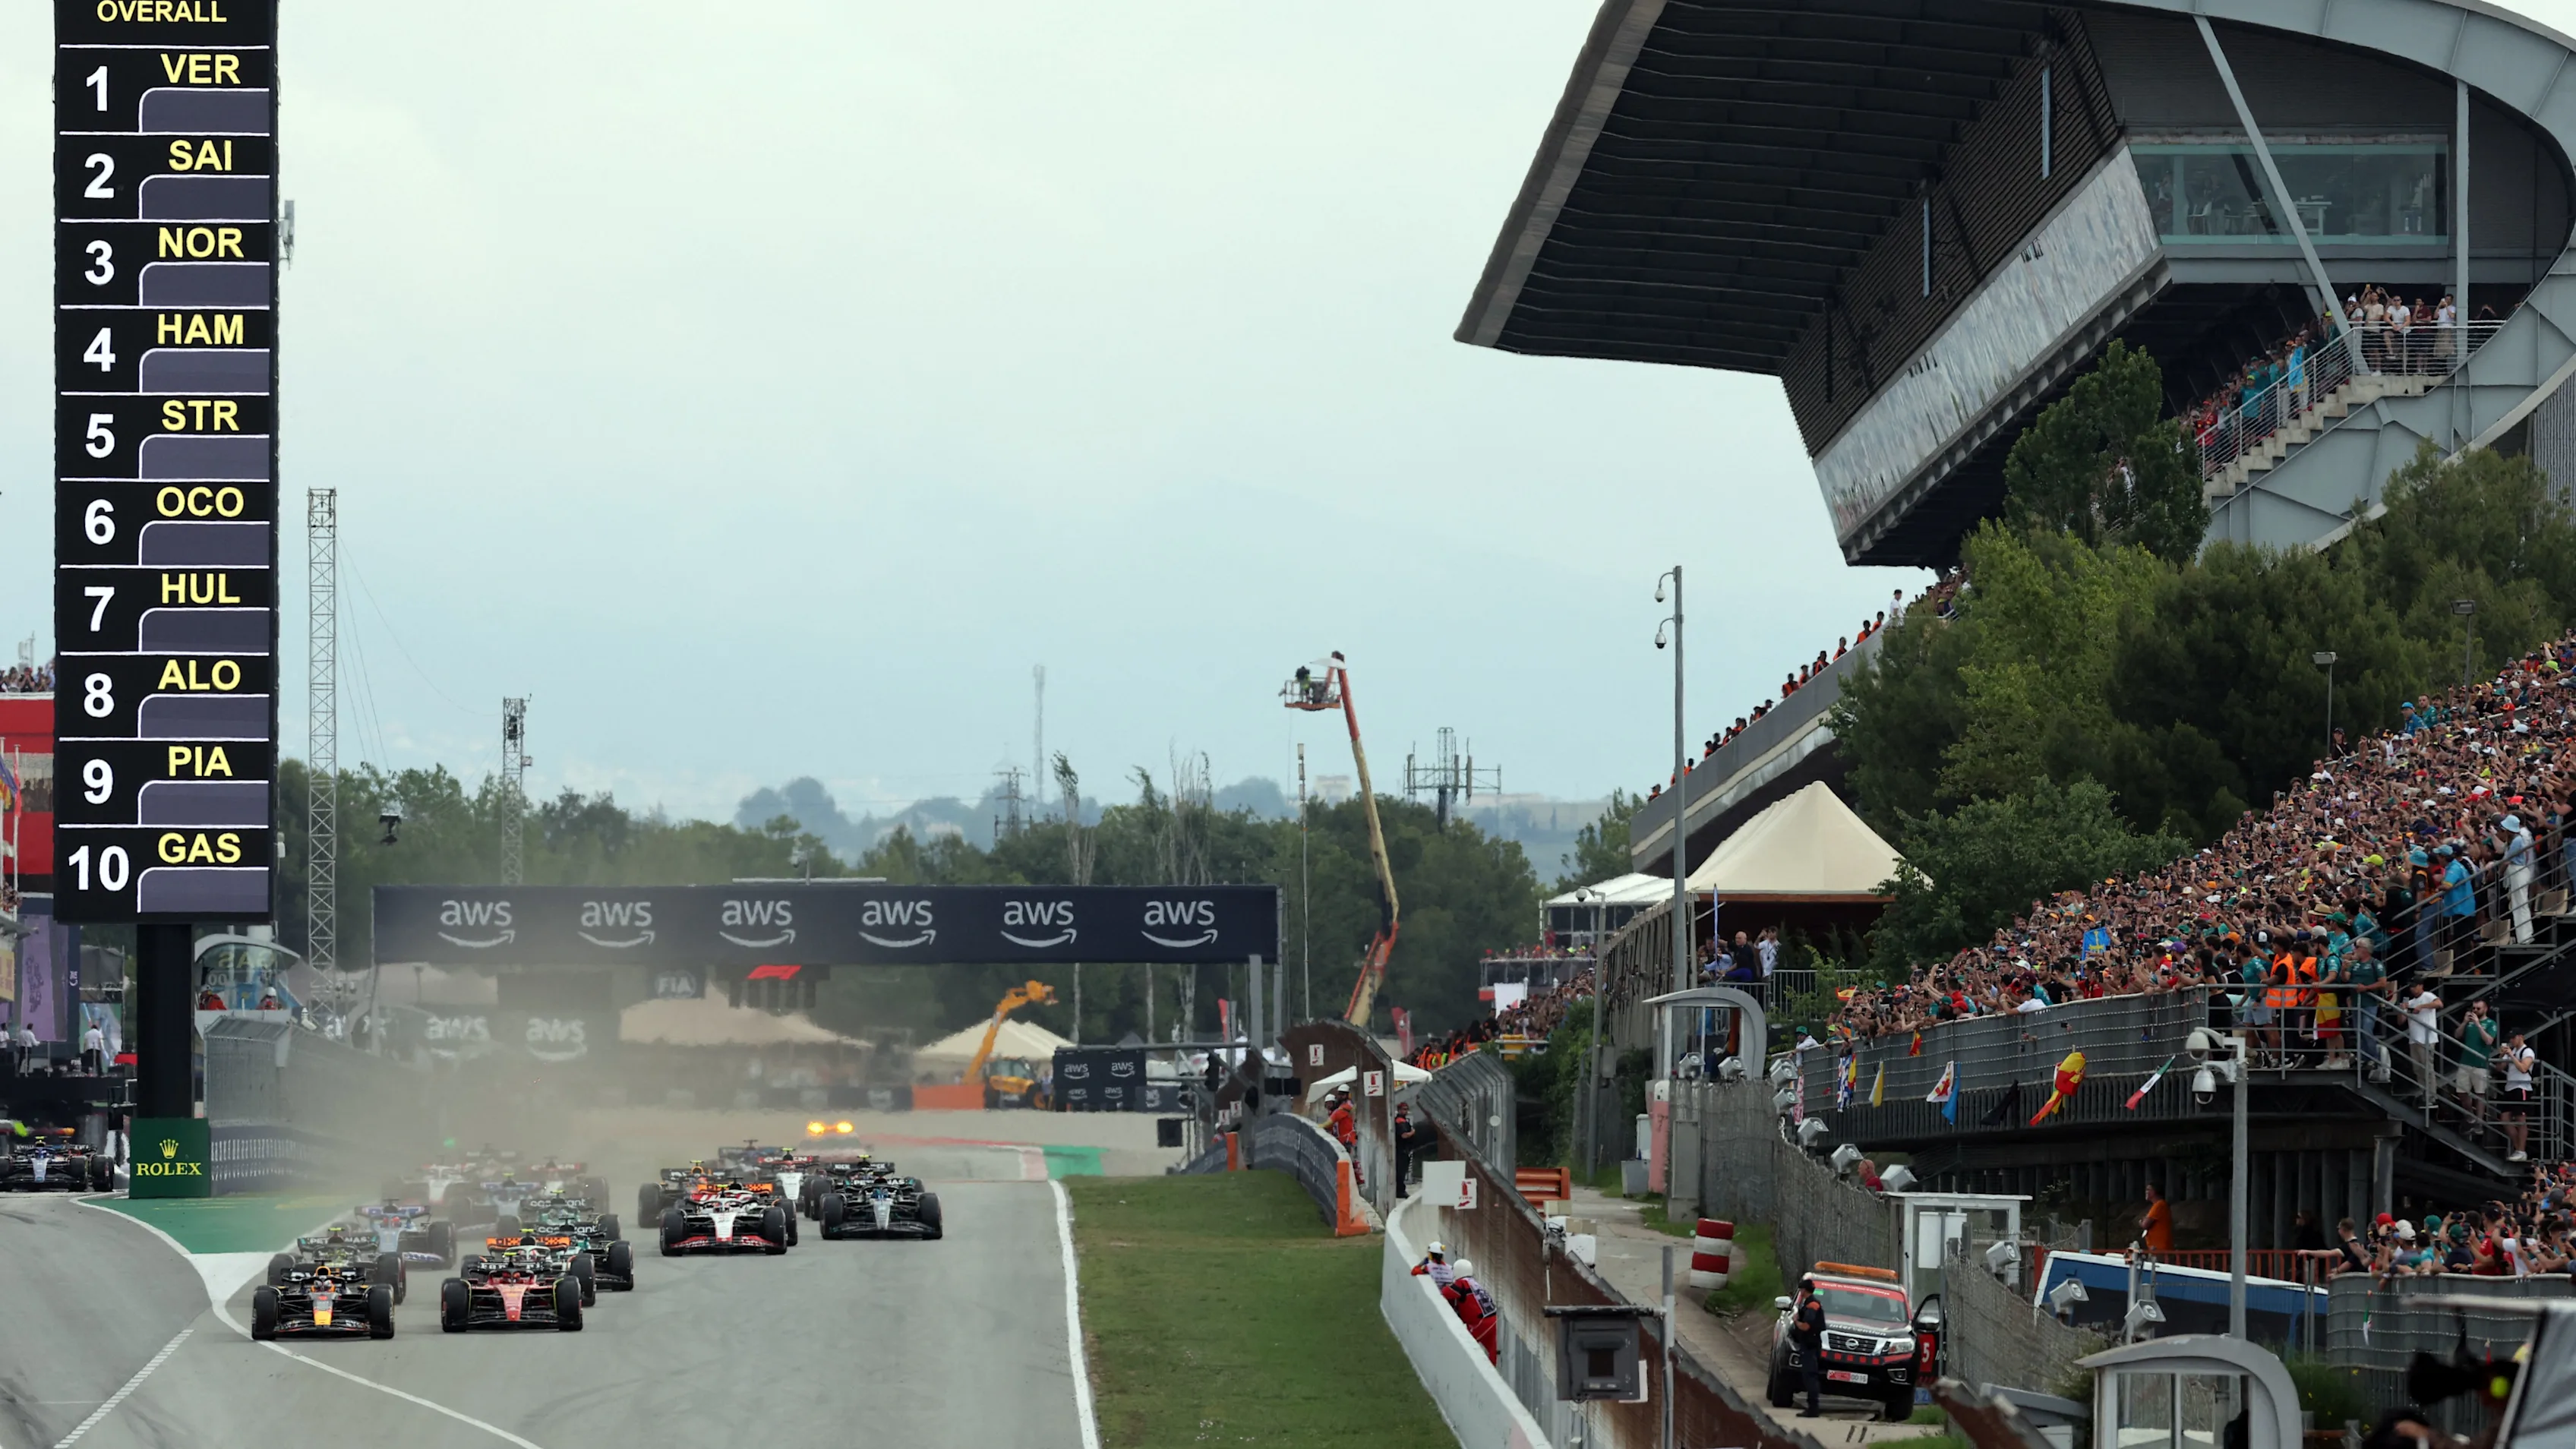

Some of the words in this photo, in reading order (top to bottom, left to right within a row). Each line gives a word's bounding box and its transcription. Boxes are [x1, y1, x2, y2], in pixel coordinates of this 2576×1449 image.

[96, 0, 227, 22] OVERALL
[161, 54, 240, 84] VER
[87, 66, 107, 111] 1
[169, 140, 231, 170] SAI
[84, 153, 114, 198] 2
[159, 228, 244, 257] NOR
[85, 240, 114, 285] 3
[158, 314, 243, 344] HAM
[84, 328, 115, 371] 4
[163, 400, 239, 431] STR
[86, 414, 115, 458] 5
[157, 487, 243, 517] OCO
[85, 500, 115, 545] 6
[163, 573, 240, 603] HUL
[85, 587, 114, 631] 7
[158, 660, 240, 690] ALO
[84, 673, 114, 717] 8
[169, 747, 232, 776] PIA
[84, 759, 112, 803] 9
[159, 833, 240, 863] GAS
[69, 846, 128, 891] 10
[440, 901, 512, 927] aws
[581, 902, 652, 927] aws
[722, 901, 792, 925] aws
[863, 901, 932, 925] aws
[1005, 901, 1074, 924] aws
[1145, 901, 1214, 924] aws
[658, 977, 692, 993] FIA
[526, 1018, 586, 1043] aws
[1064, 1063, 1089, 1073] aws
[1111, 1062, 1134, 1072] aws
[136, 1162, 202, 1176] ROLEX
[1922, 1343, 1930, 1363] 5
